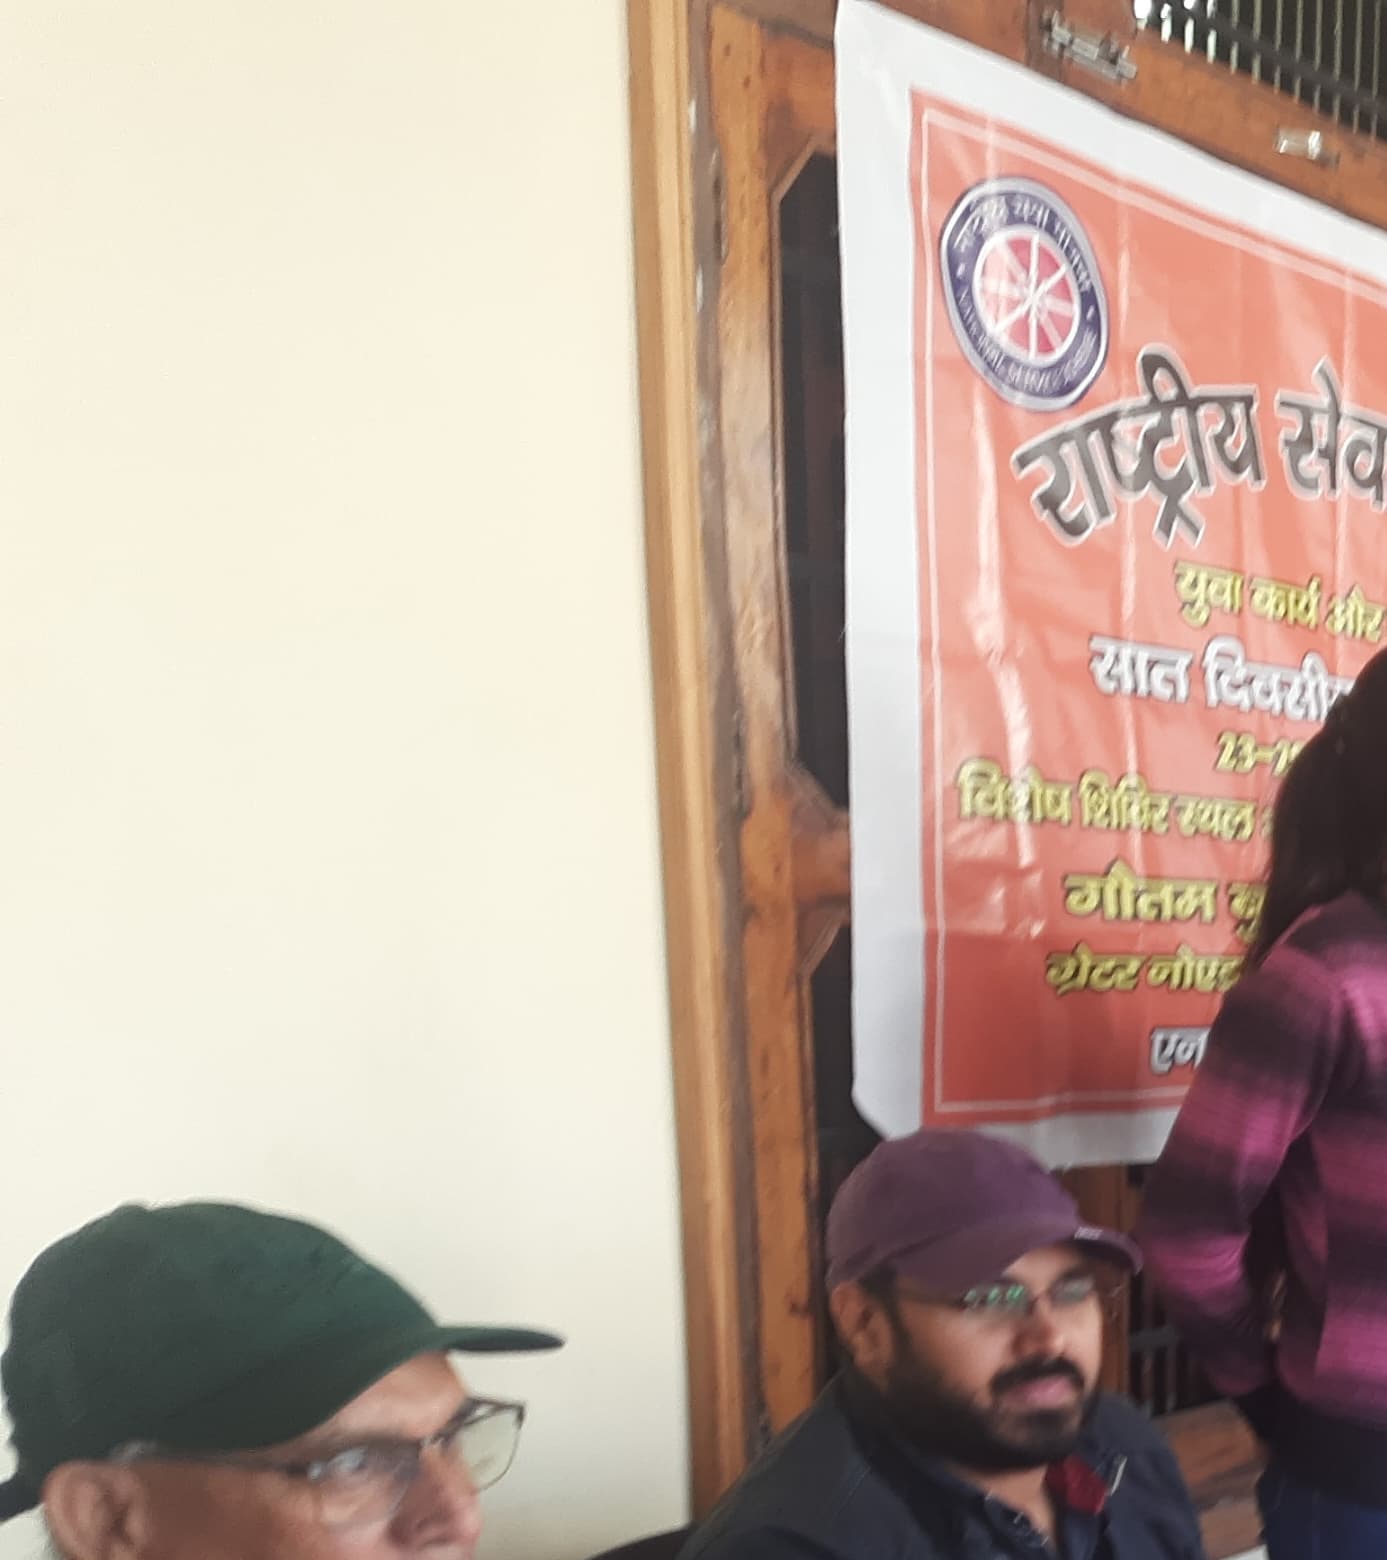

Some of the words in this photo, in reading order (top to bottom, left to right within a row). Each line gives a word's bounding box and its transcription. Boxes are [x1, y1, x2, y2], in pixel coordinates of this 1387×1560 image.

[1014, 349, 1264, 547] राष्ट्रीय
[1175, 562, 1243, 628] युवा
[1250, 576, 1320, 630] कार्य
[1089, 635, 1194, 703] सात
[1064, 858, 1217, 923] गौतम
[1046, 941, 1146, 996] ग्रेटर
